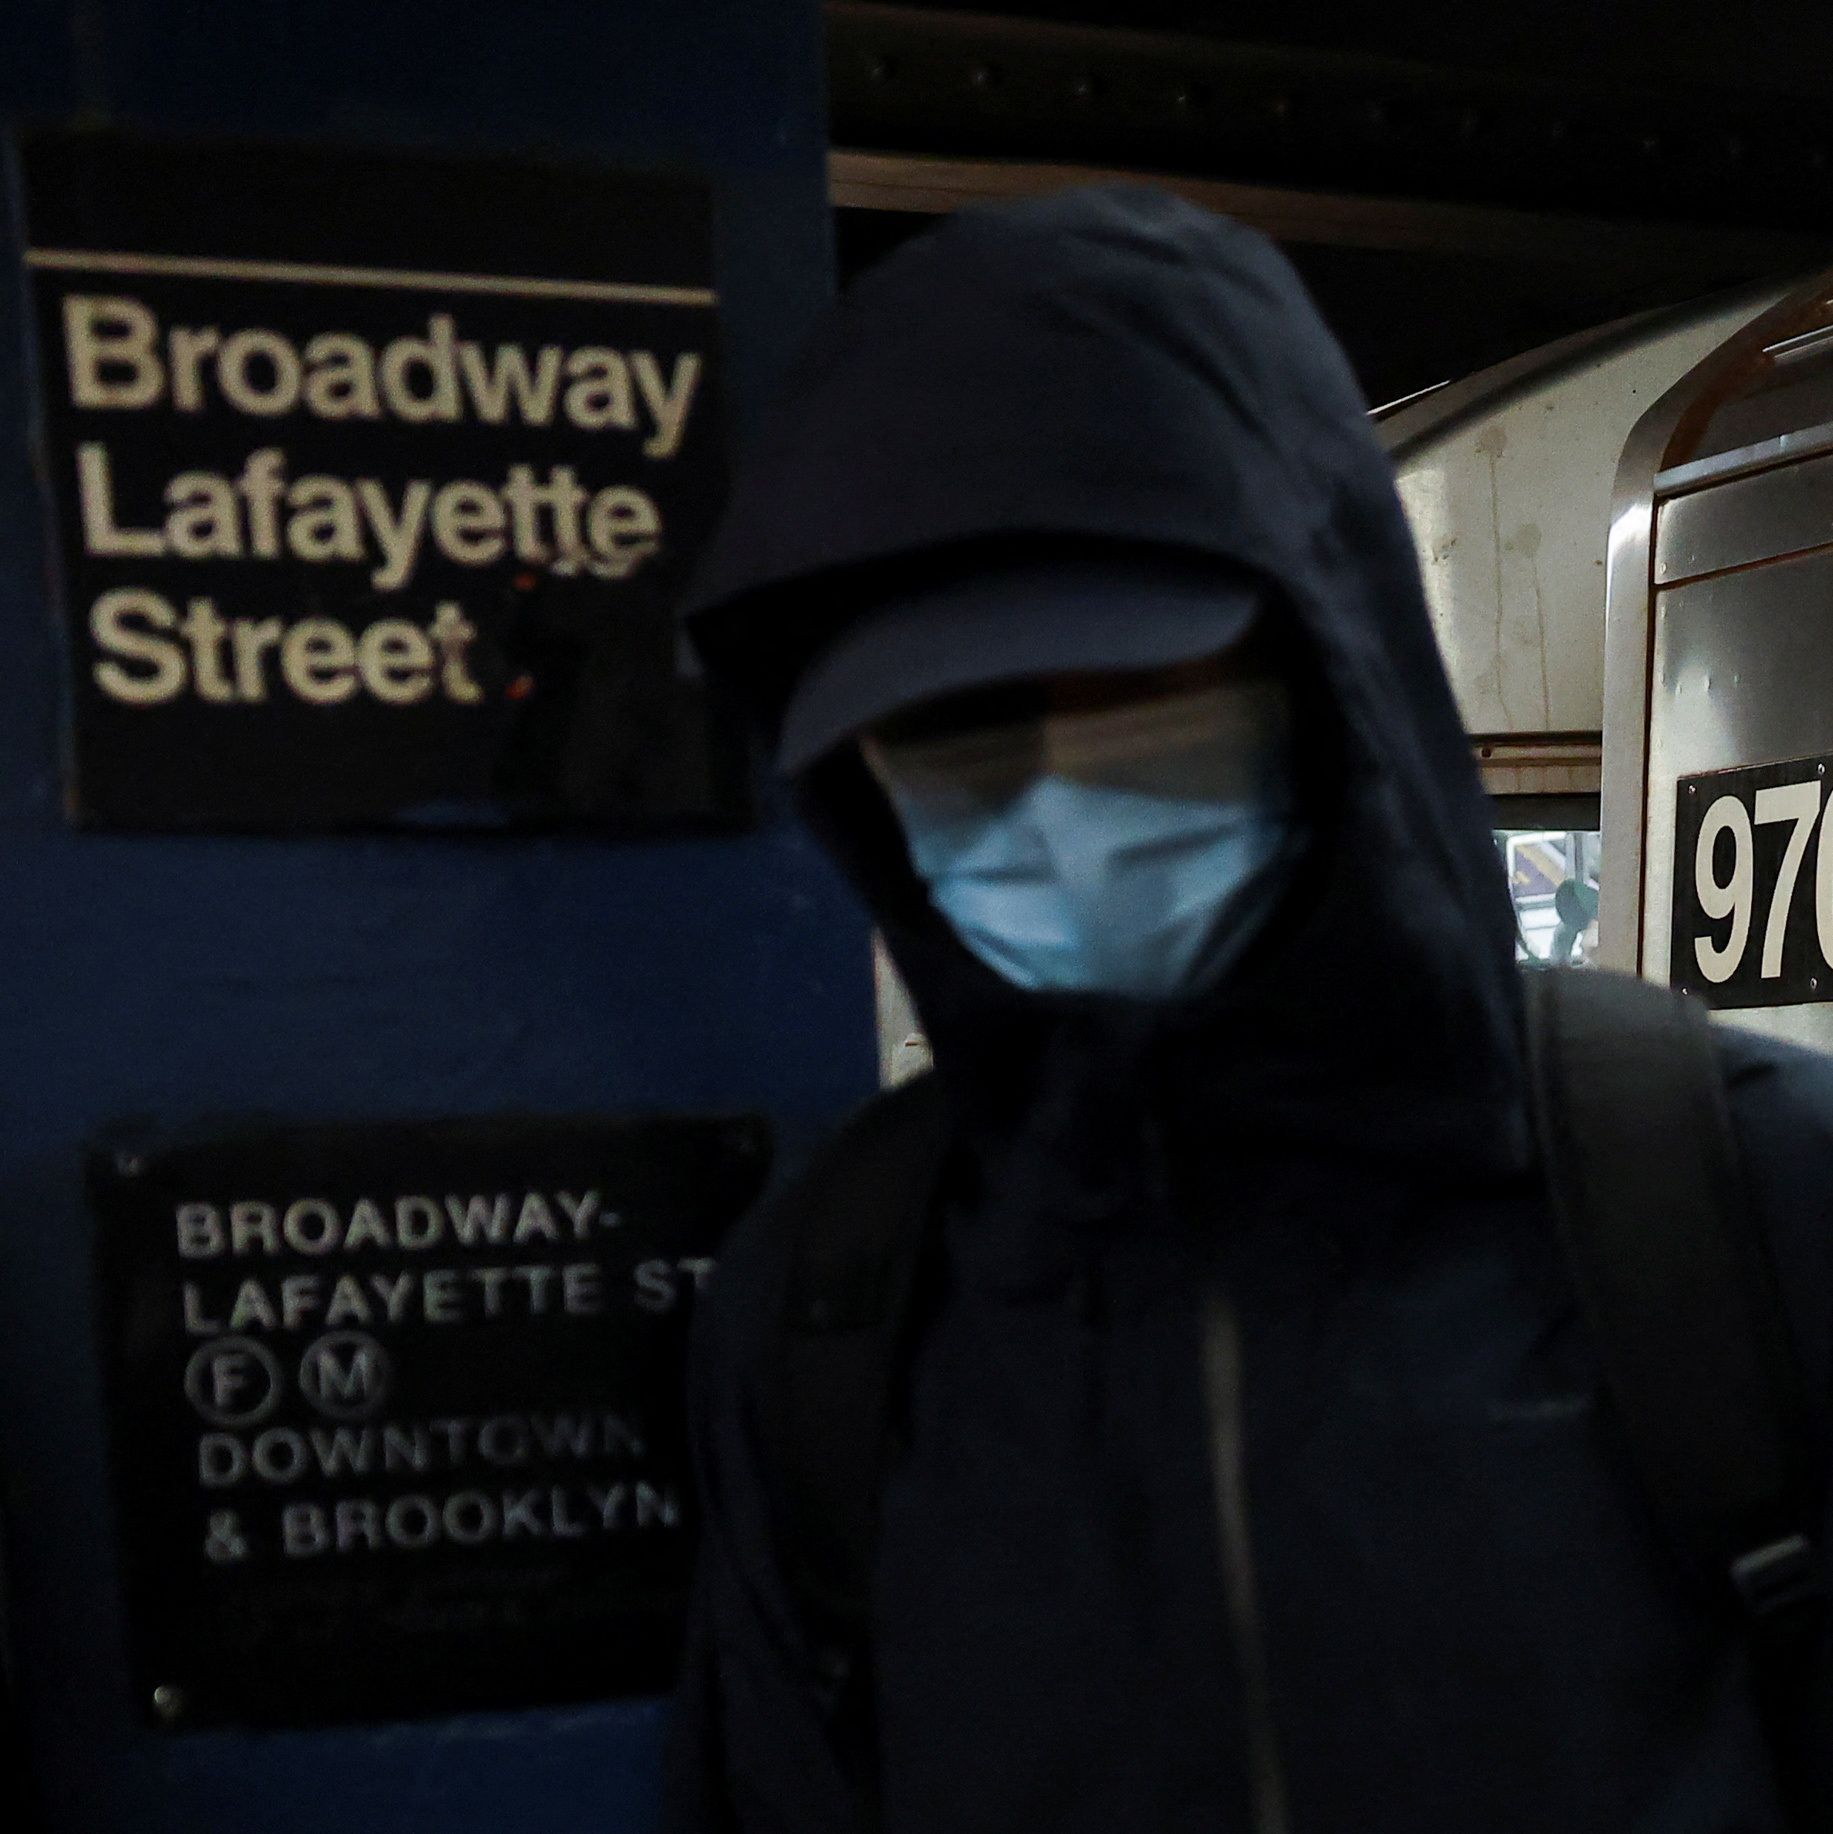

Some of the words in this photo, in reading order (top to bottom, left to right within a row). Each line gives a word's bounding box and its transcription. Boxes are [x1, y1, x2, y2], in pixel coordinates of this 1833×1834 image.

[62, 292, 701, 459] Broadway
[76, 441, 663, 592] Lafayette
[89, 587, 485, 705] Street
[183, 1261, 606, 1336] LAFAYETTE
[197, 1412, 646, 1490] DOWNTOWN
[203, 1506, 248, 1566] &
[281, 1478, 685, 1561] BROOKLYN
